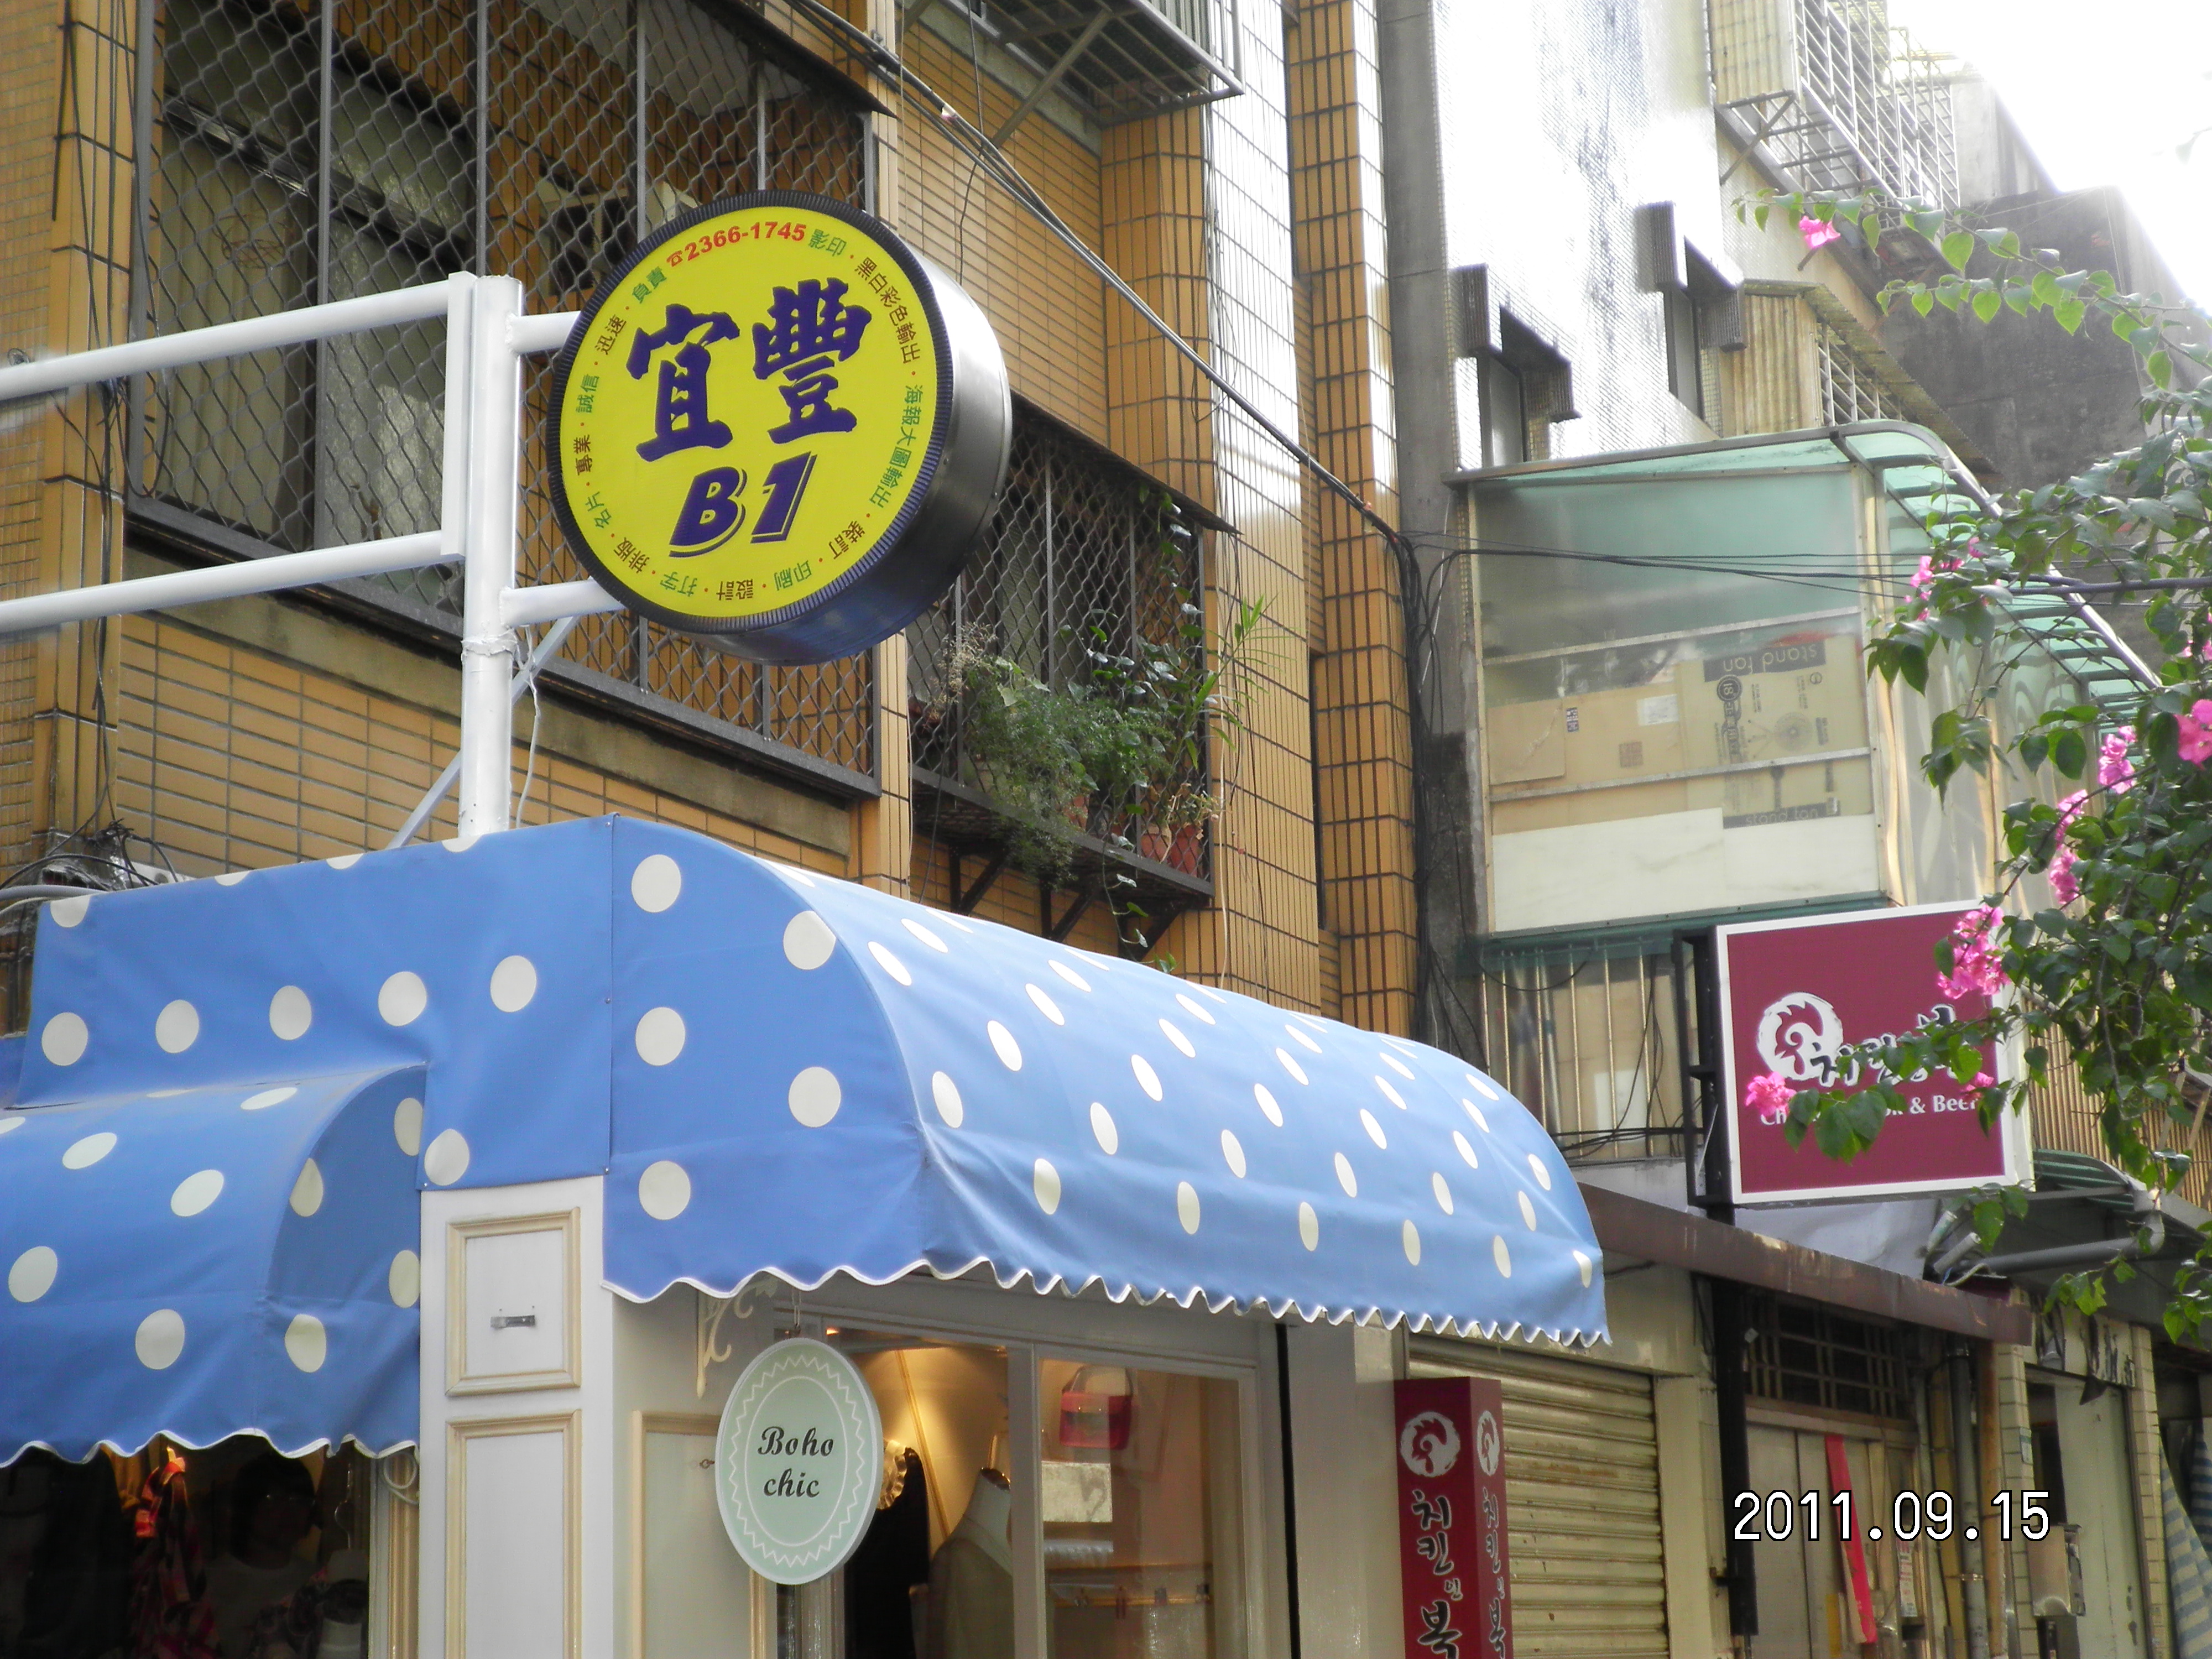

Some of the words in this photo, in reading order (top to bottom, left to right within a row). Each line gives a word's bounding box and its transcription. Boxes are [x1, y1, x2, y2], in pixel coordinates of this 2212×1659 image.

[685, 222, 806, 261] 2366-1745
[808, 228, 847, 257] 影印
[632, 266, 667, 304] 負責
[854, 257, 921, 364] 黑白彩色輸出
[594, 314, 627, 355] 迅速
[626, 277, 872, 462] 宜豐
[576, 374, 599, 414] 誠信
[573, 435, 593, 476] 專業
[869, 384, 923, 508] 海報大圖輸出
[585, 491, 612, 529] 名片
[669, 451, 818, 557] B1
[614, 537, 650, 573] 排版
[828, 520, 866, 560] 裝訂
[660, 571, 698, 597] 打字
[716, 579, 754, 601] 設計
[774, 560, 812, 591] 印刷
[1723, 656, 1753, 674] fan
[1762, 644, 1817, 672] stand
[1910, 1097, 1926, 1114] &
[758, 1426, 834, 1457] Boho
[764, 1468, 820, 1498] chic
